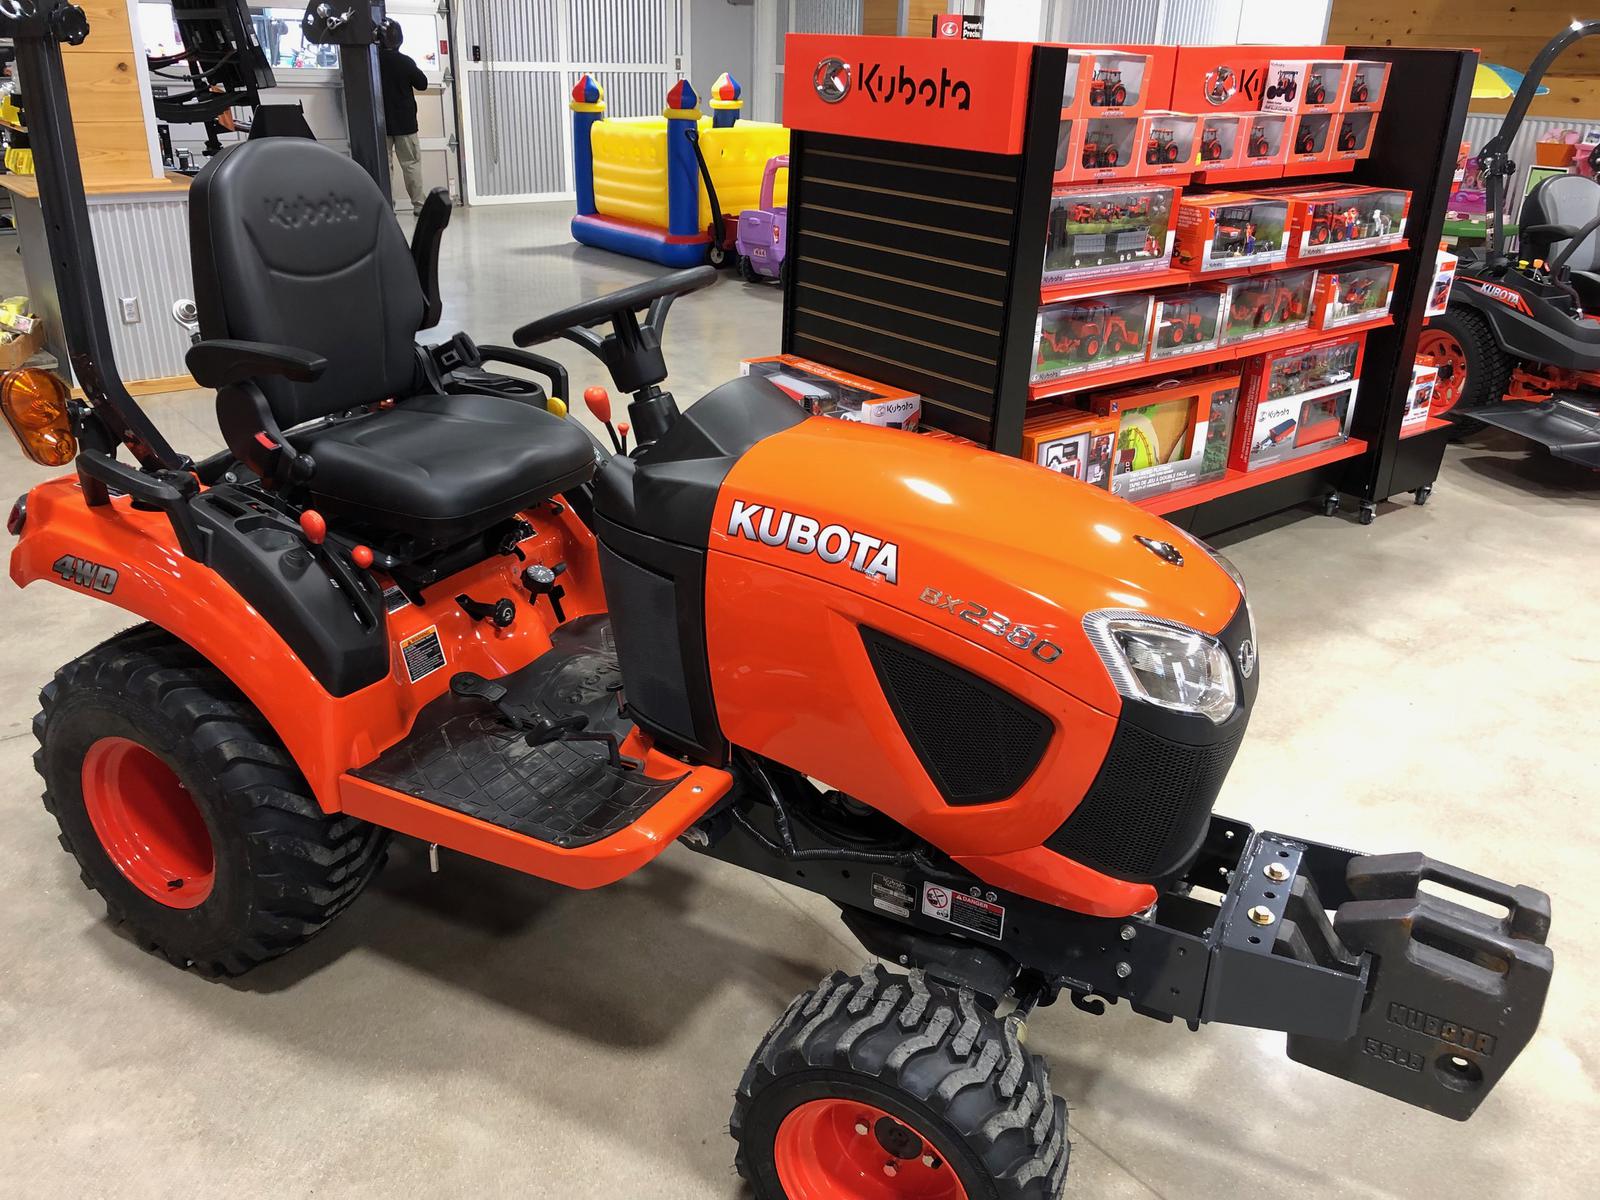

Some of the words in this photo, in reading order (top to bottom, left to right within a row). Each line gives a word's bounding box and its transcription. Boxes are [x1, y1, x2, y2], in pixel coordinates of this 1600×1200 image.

[858, 63, 971, 110] Kubota
[264, 192, 359, 229] Kubota
[1481, 283, 1519, 304] KUBOTA
[886, 402, 913, 413] Kubota
[1267, 408, 1290, 419] Kubota
[727, 499, 899, 585] KUBOTA
[52, 554, 119, 595] 4WD
[918, 586, 1063, 664] BX2380
[962, 896, 989, 909] DANGER
[1388, 1002, 1497, 1056] KUBOTA
